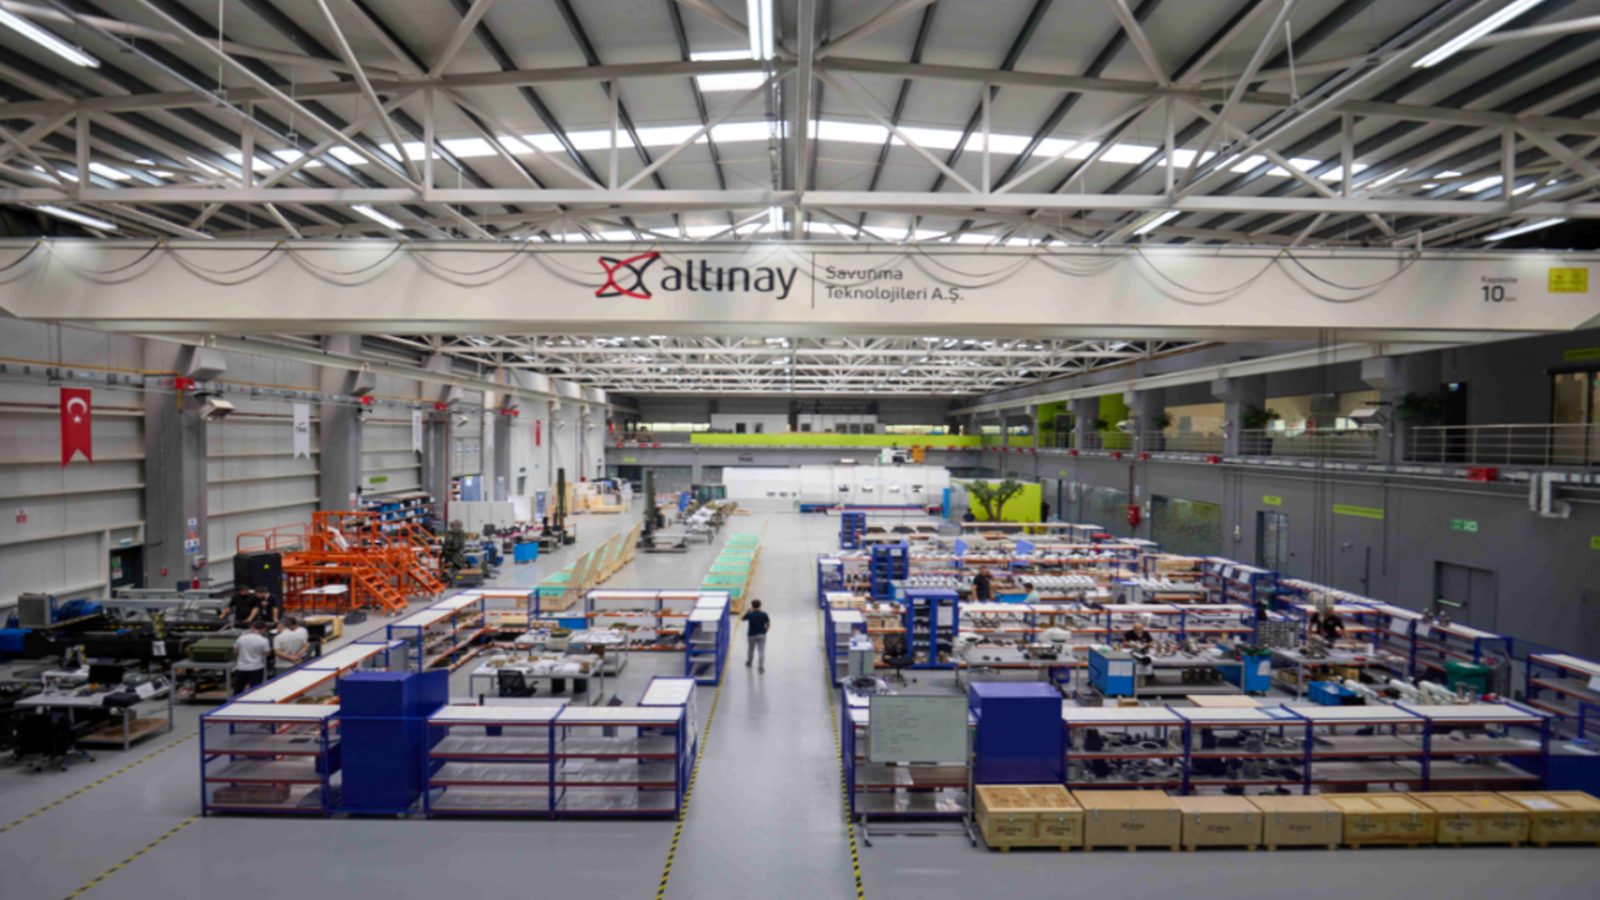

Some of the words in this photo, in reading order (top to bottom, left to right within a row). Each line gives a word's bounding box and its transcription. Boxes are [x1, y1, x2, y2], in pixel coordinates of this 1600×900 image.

[661, 258, 798, 300] altınay
[826, 266, 904, 281] Savunma
[826, 285, 928, 303] Teknolojileri
[932, 287, 964, 304] A.Ş.
[1481, 285, 1505, 302] 10
